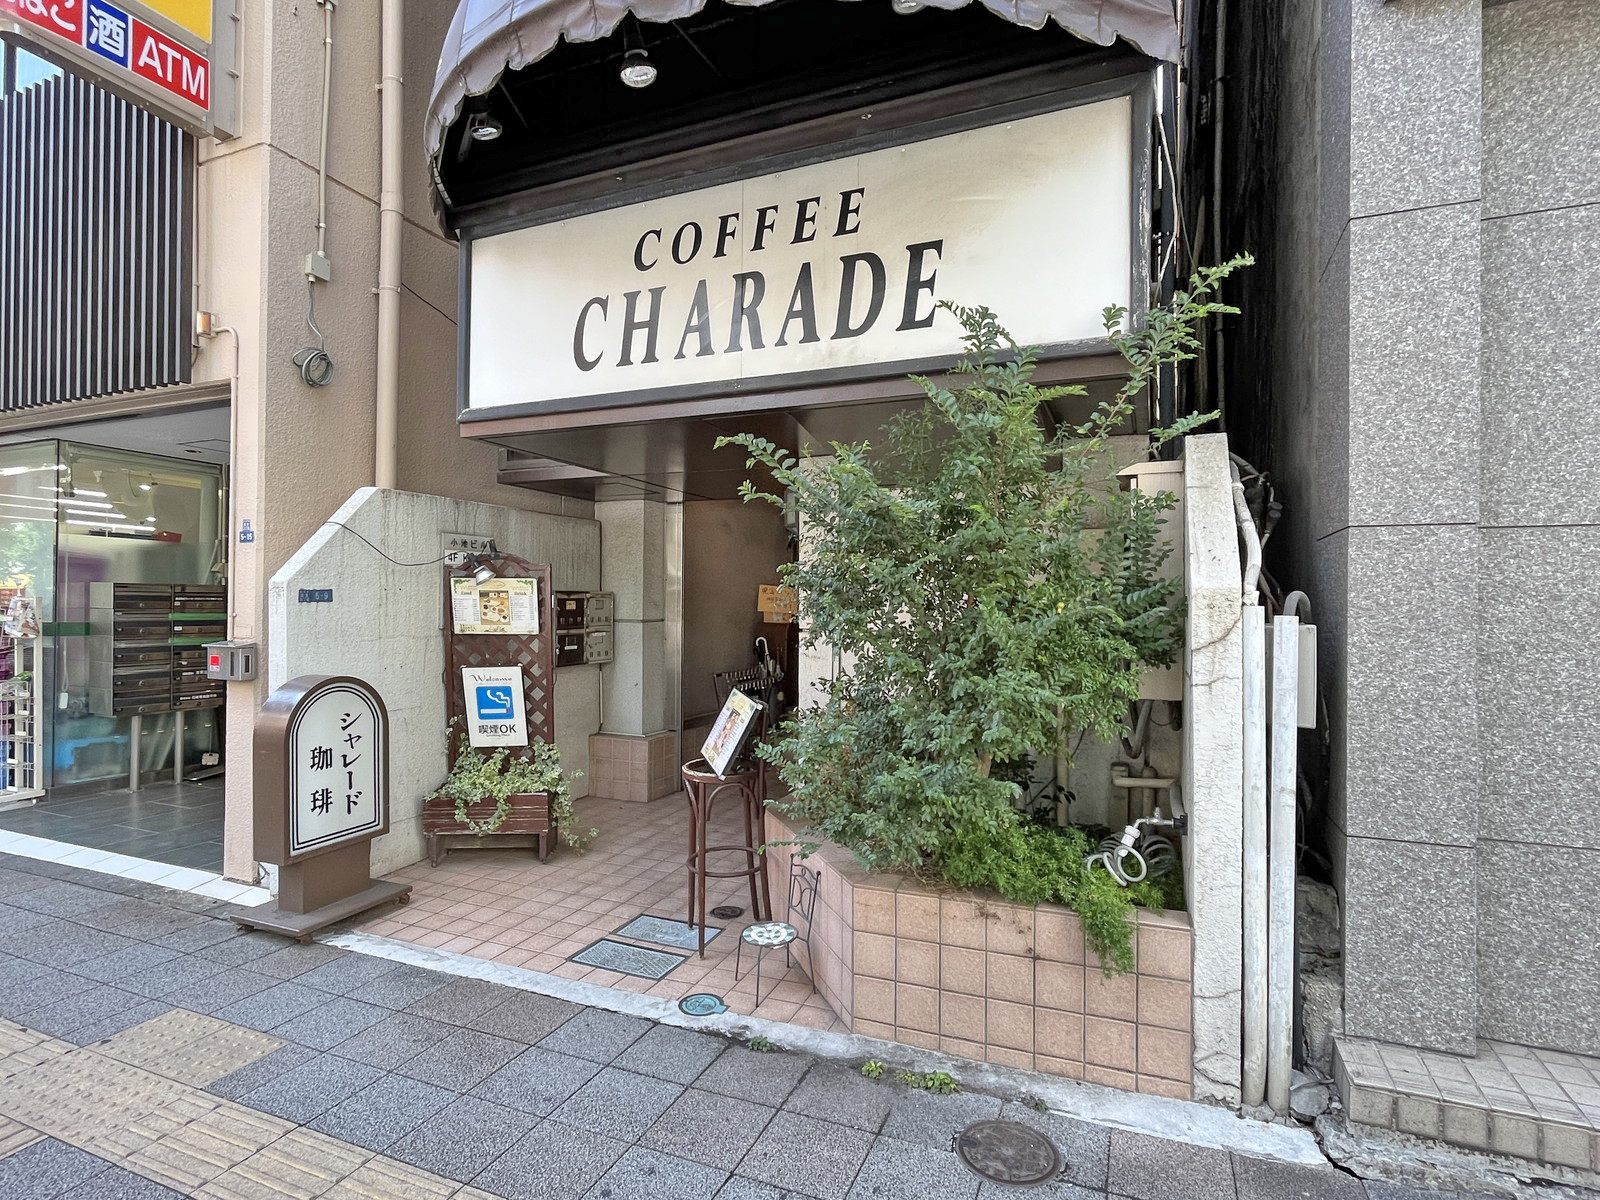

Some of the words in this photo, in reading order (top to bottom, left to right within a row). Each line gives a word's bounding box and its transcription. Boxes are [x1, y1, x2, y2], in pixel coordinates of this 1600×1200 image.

[89, 5, 126, 57] 酒
[138, 36, 204, 100] ATM
[634, 187, 865, 271] COFFEE
[573, 239, 944, 372] CHARADE
[470, 674, 512, 682] Welcome
[478, 724, 517, 734] 喫煙OK
[310, 746, 333, 816] 珈琲
[340, 712, 363, 815] シャレード
